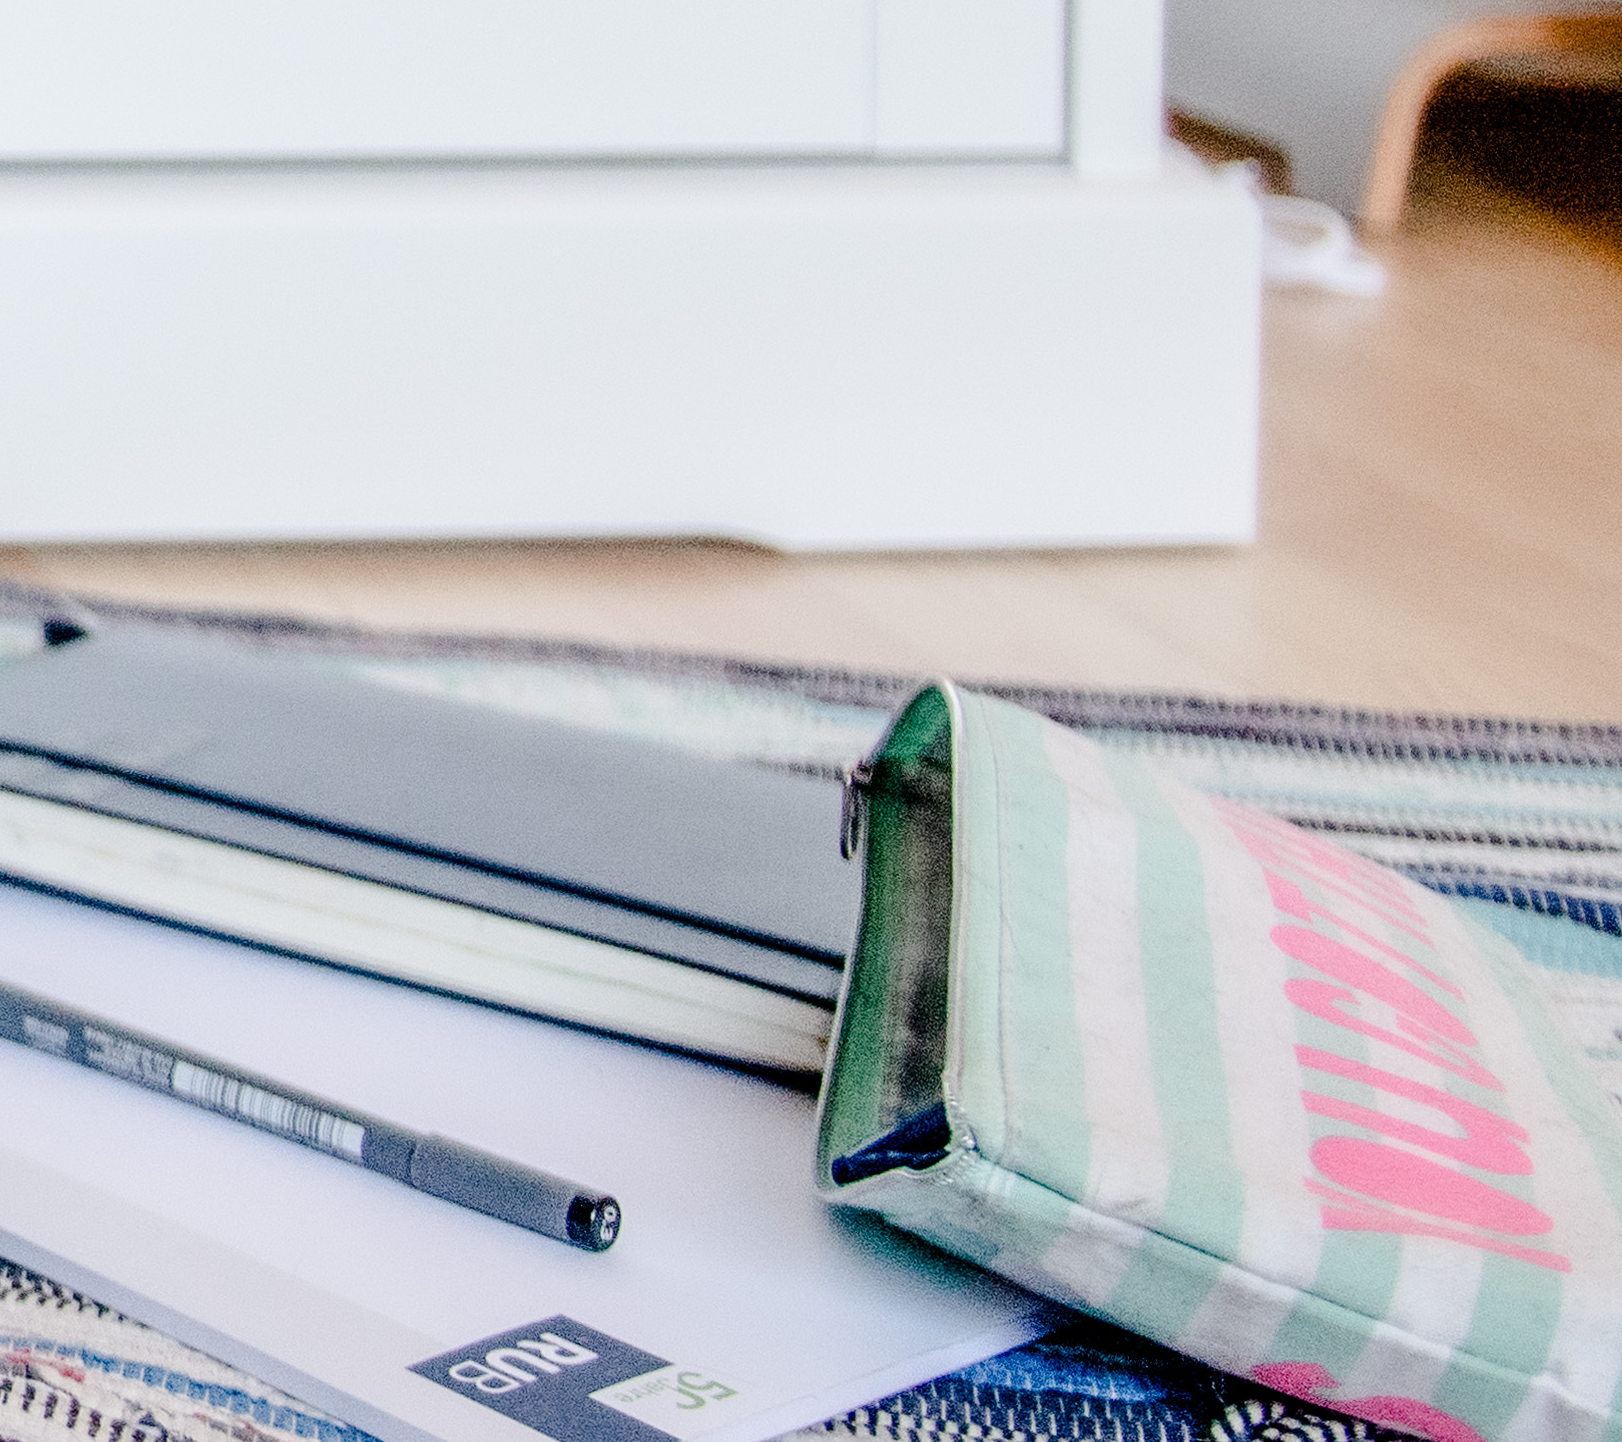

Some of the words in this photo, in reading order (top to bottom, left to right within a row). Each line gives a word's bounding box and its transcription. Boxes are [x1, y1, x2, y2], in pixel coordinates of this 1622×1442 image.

[1259, 865, 1509, 1094] GOT
[1294, 1043, 1574, 1275] YOU
[448, 1332, 599, 1396] RUB
